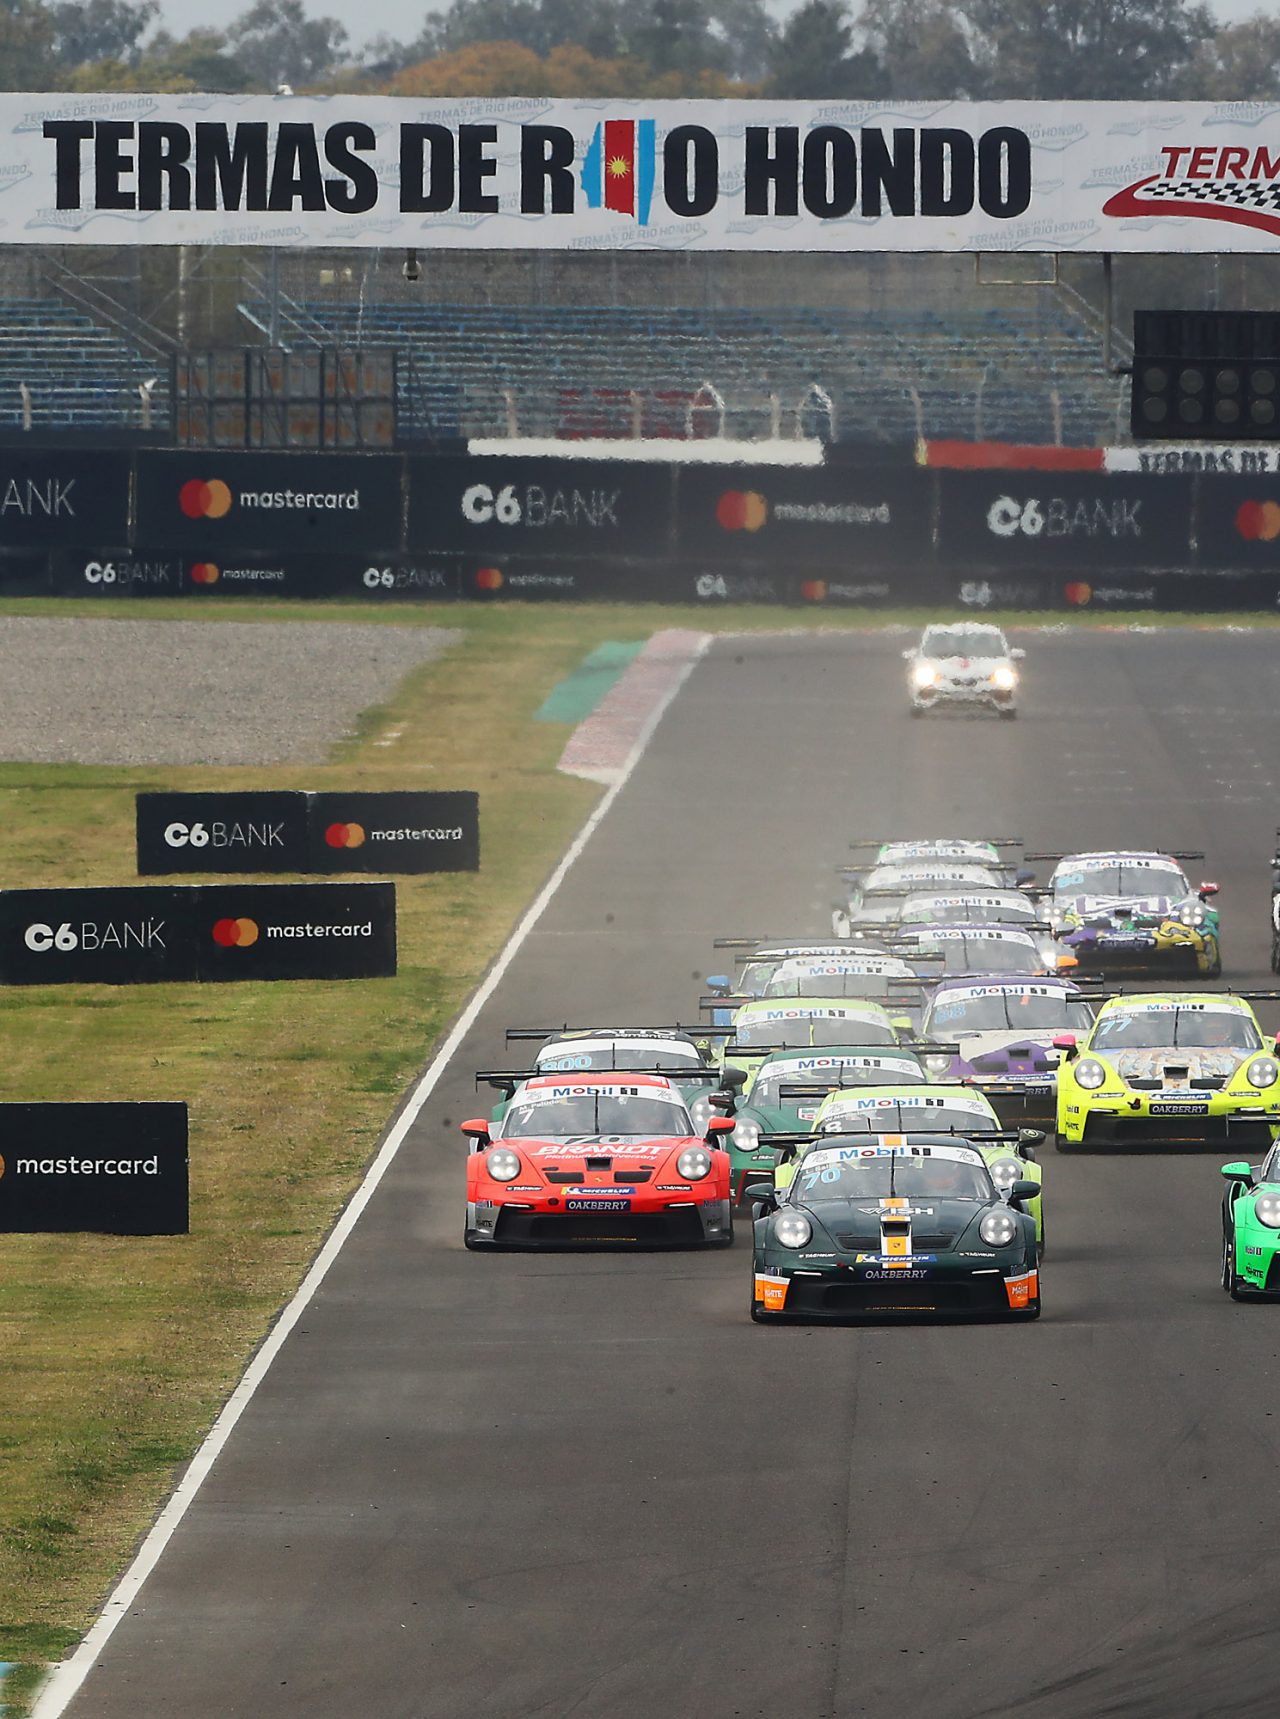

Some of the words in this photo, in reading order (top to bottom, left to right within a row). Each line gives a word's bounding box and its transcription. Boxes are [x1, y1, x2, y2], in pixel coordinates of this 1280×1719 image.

[43, 121, 378, 214] TERMAS
[400, 123, 498, 213] DE
[745, 126, 1031, 218] HONDO
[240, 489, 360, 510] mastercard
[462, 483, 522, 525] C6
[525, 486, 620, 528] BANK
[987, 495, 1043, 537] C6
[1046, 497, 1142, 537] BANK
[85, 562, 116, 584] C6
[117, 563, 169, 583] BANK
[223, 567, 285, 581] mastercard
[363, 567, 395, 589] C6
[164, 822, 209, 848] C6
[212, 822, 284, 848] BANK
[371, 827, 463, 841] mastercard
[24, 922, 78, 952] C6
[81, 920, 166, 951] BANK
[267, 921, 373, 940] mastercard
[971, 986, 1025, 996] Mobil
[766, 1009, 824, 1020] Mobil
[1099, 1017, 1133, 1036] 77
[798, 1057, 858, 1069] Mobil
[552, 1087, 613, 1097] Mobil
[757, 1083, 768, 1097] 1
[857, 1098, 920, 1110] Mobil
[1152, 1105, 1206, 1114] OAKBERRY
[519, 1108, 535, 1125] 7
[825, 1120, 842, 1133] 8
[531, 1145, 672, 1156] BRANDT
[839, 1147, 905, 1161] Mobil
[16, 1156, 159, 1176] mastercard
[801, 1167, 842, 1191] 70
[581, 1187, 631, 1195] MICHELIN
[569, 1201, 628, 1211] OAKBERRY
[858, 1206, 935, 1217] WISH
[866, 1270, 929, 1280] OAKBERRY
